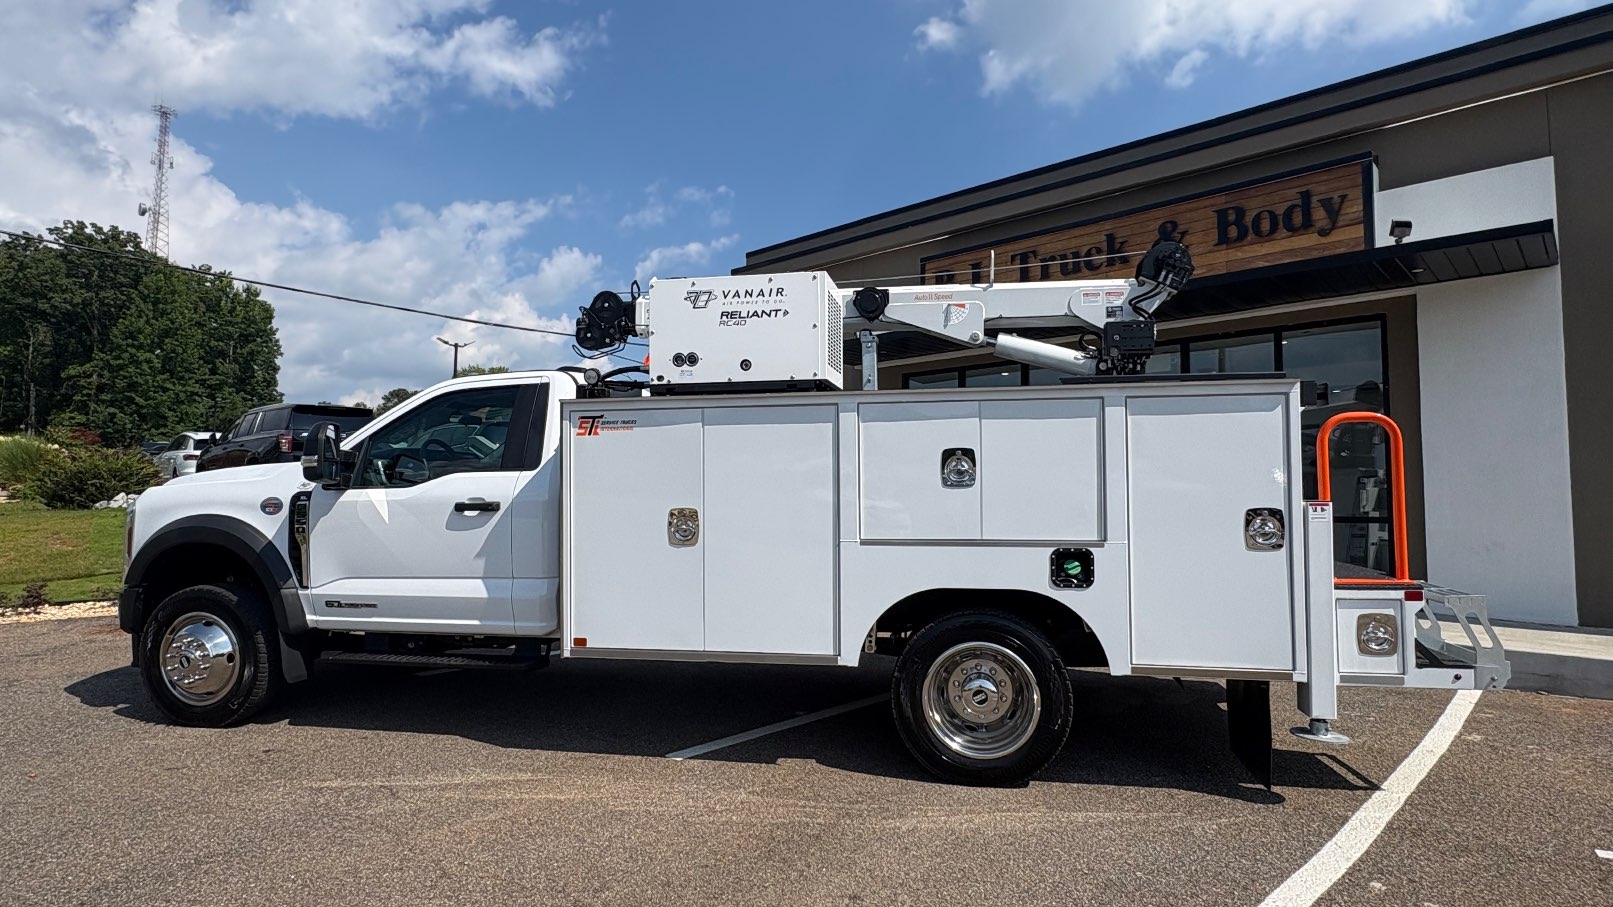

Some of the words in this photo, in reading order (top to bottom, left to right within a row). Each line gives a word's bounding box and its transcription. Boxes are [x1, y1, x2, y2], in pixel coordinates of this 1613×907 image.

[1010, 233, 1130, 283] Truck
[1213, 190, 1348, 247] Body
[722, 287, 785, 299] VANAIR
[934, 293, 954, 301] Speed
[720, 309, 782, 319] RELIANT
[719, 319, 747, 327] RC40
